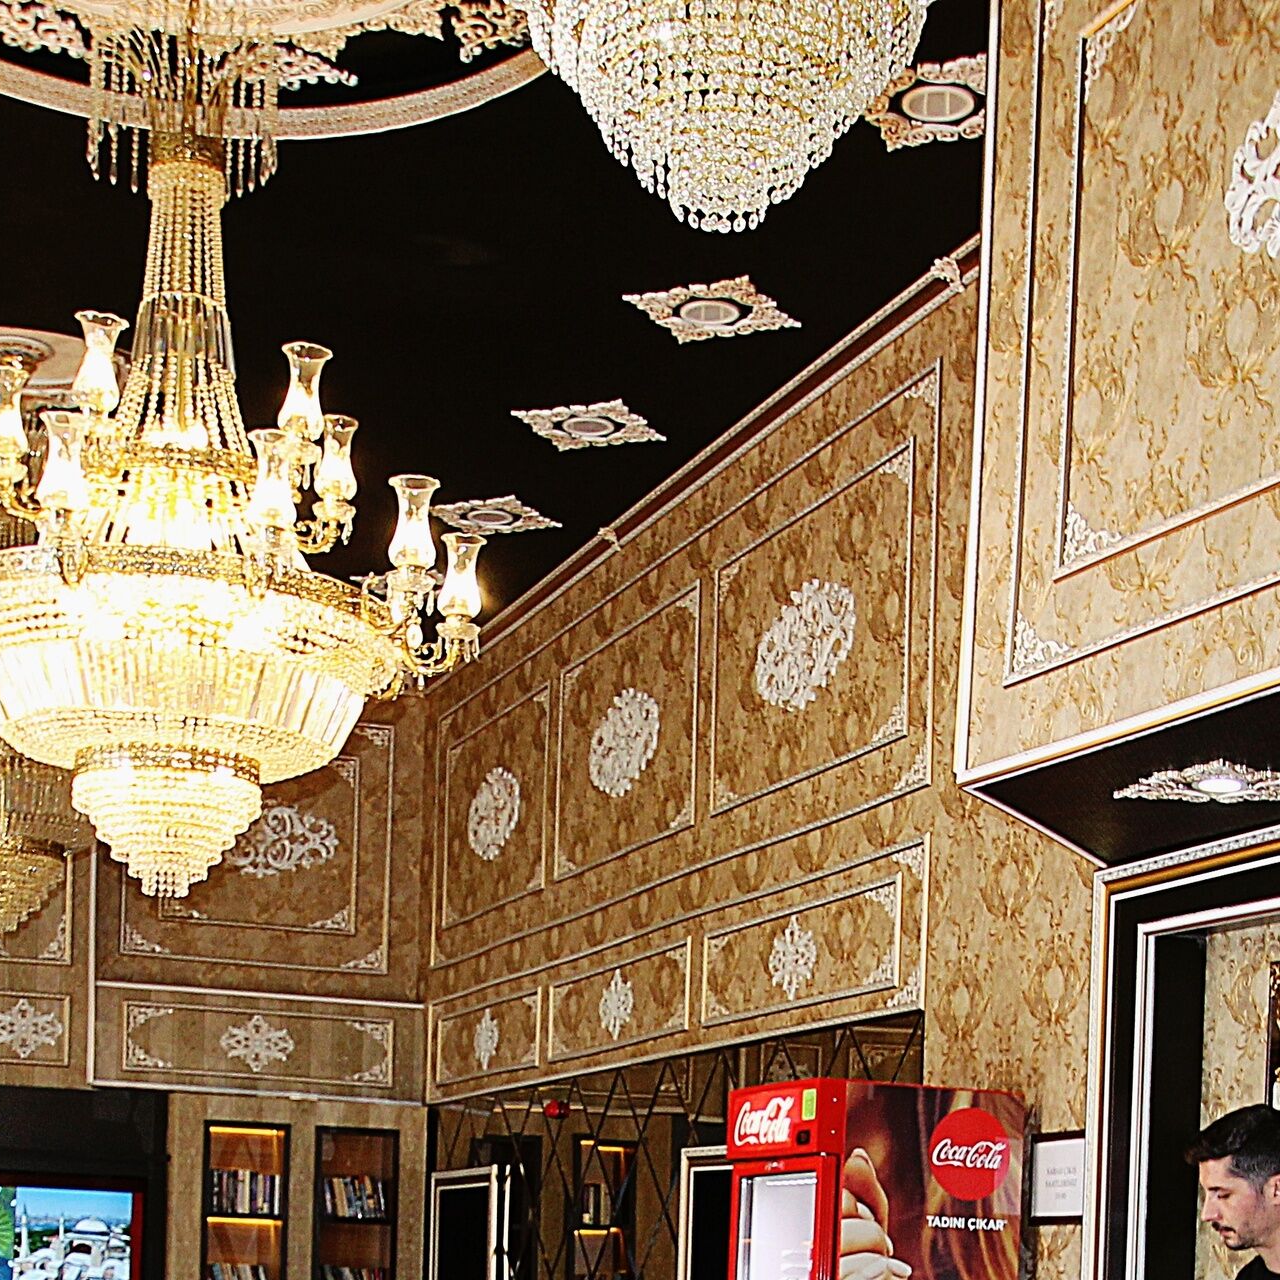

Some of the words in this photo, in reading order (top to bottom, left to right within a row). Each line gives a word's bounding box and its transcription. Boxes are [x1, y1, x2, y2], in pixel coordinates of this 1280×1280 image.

[932, 1138, 1006, 1169] Coca-Cola
[926, 1215, 965, 1229] TADINI
[967, 1217, 1004, 1231] ÇIKAR
